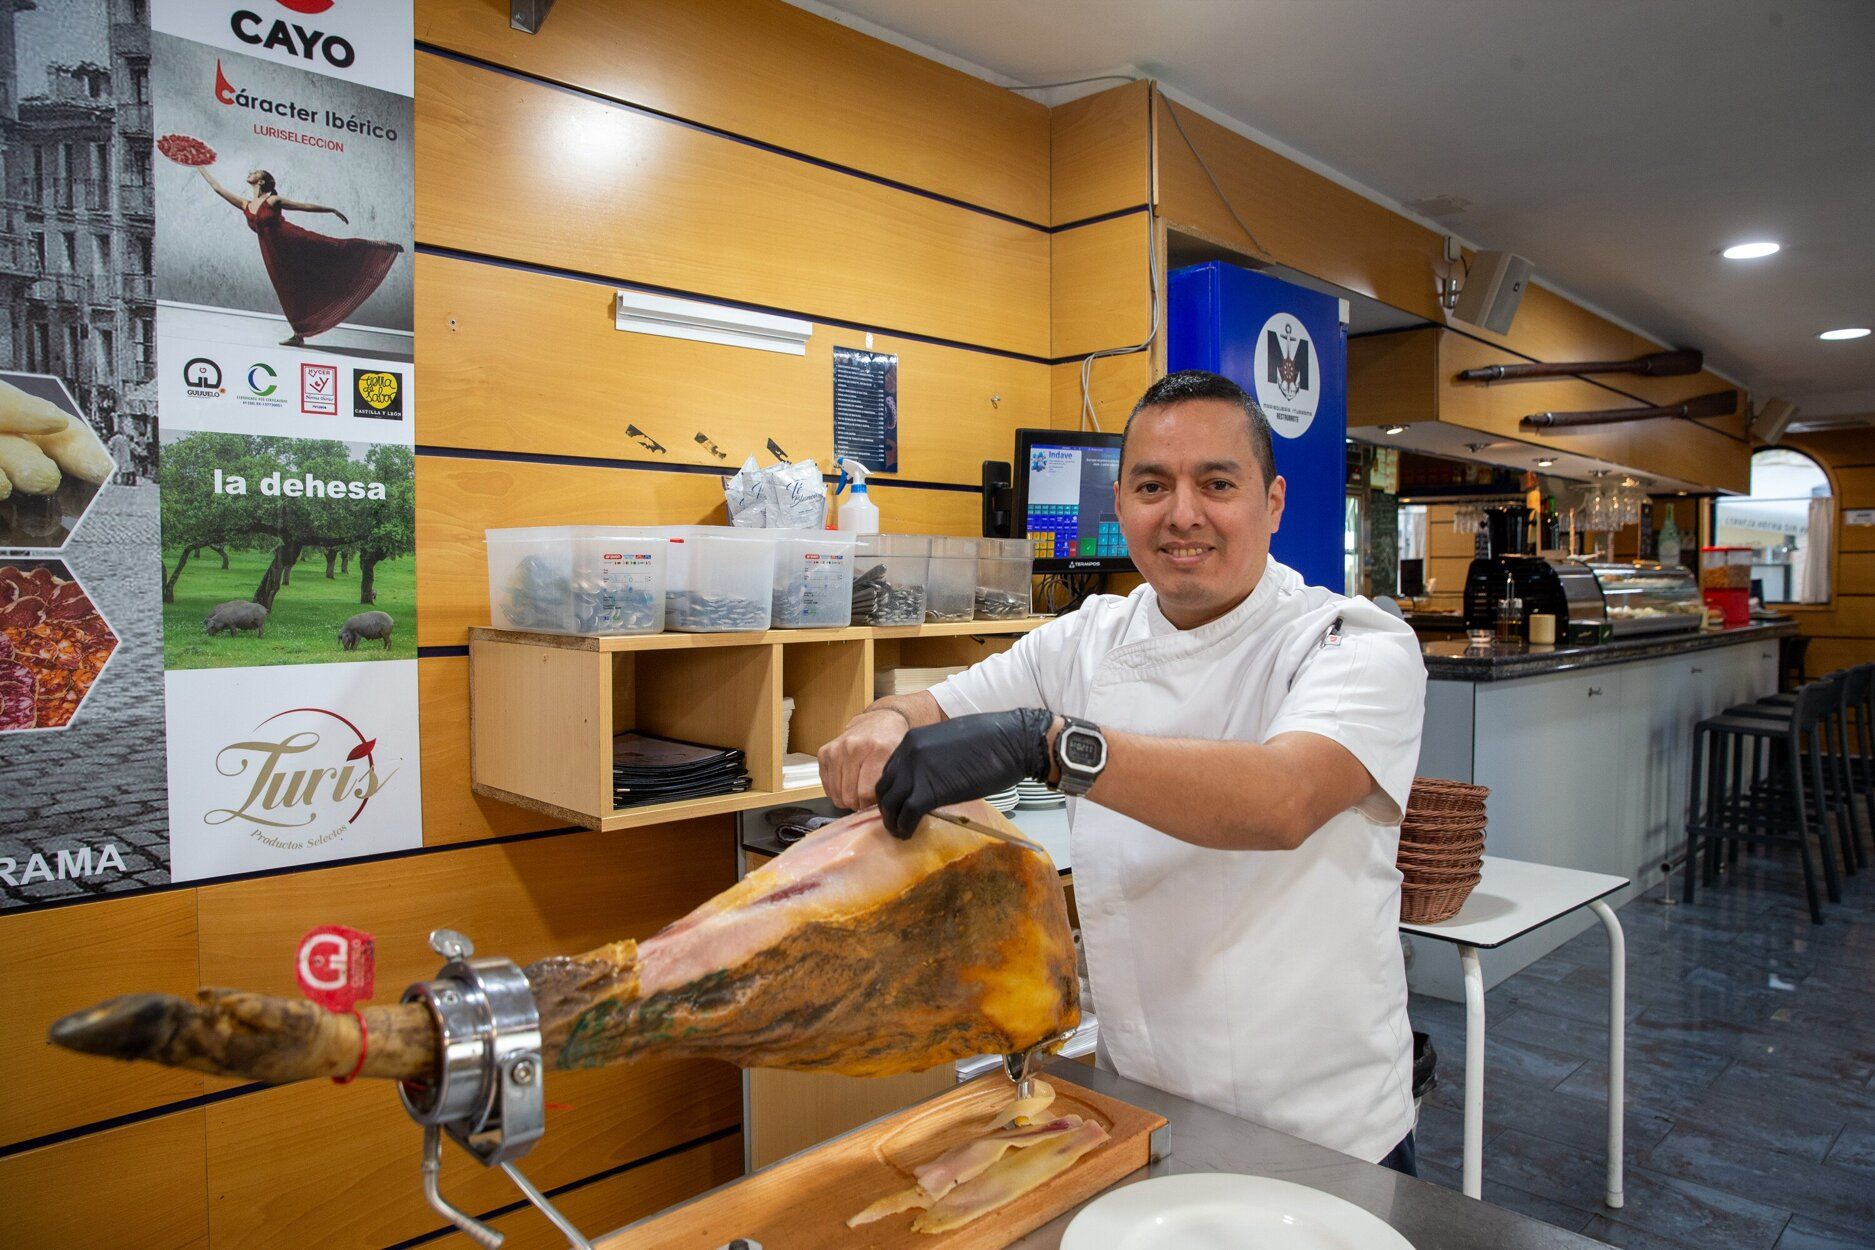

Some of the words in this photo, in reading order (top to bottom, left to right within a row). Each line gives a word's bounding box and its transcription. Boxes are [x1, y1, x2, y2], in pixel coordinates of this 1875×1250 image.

[230, 10, 356, 68] CAYO
[253, 123, 344, 153] LURISELECCION
[325, 111, 398, 142] Ibérico
[187, 389, 220, 398] GUIJUELO
[1048, 450, 1073, 459] Indave
[213, 469, 247, 496] la
[260, 471, 387, 500] dehesa
[250, 828, 304, 850] Productos
[306, 824, 348, 850] Selectos
[0, 843, 128, 887] RAMA
